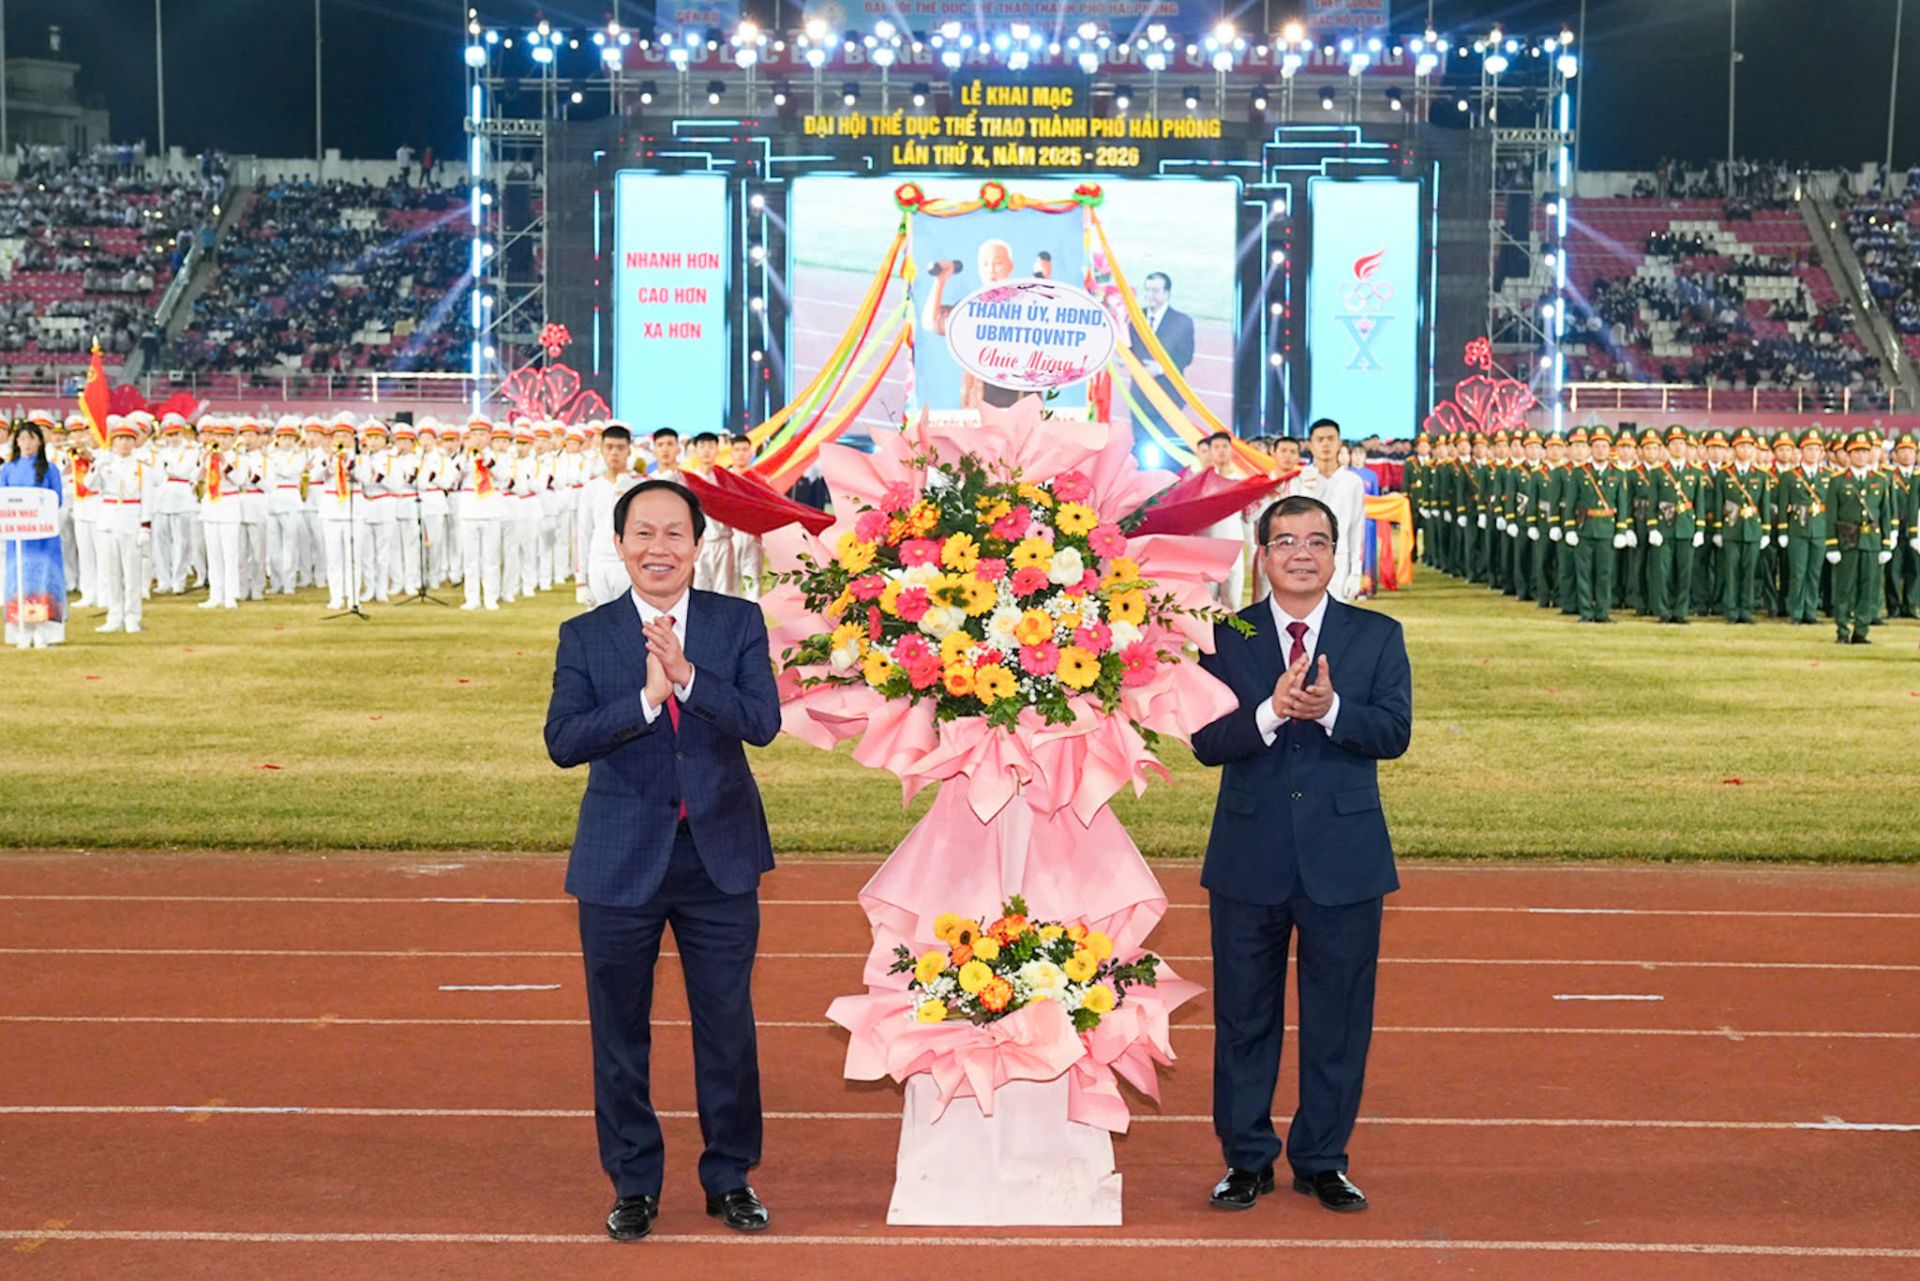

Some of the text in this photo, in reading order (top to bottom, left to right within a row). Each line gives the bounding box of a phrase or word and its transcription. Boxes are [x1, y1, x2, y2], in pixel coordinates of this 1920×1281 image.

[961, 80, 1073, 110] LỄ KHAI MẠC
[804, 108, 1221, 139] ĐẠI HỘI THỂ DỤC THỂ THAO THÀNH PHỐ HẢI PHÒNG
[893, 139, 1139, 167] LẦN THỨ X, NĂM 2025 - 2026
[626, 252, 719, 269] NHANH HƠN
[638, 287, 707, 304] CAO HƠN
[1055, 307, 1107, 328] HĐND,
[643, 322, 702, 339] XA HƠN
[975, 324, 1087, 347] UBMTTQVNTP
